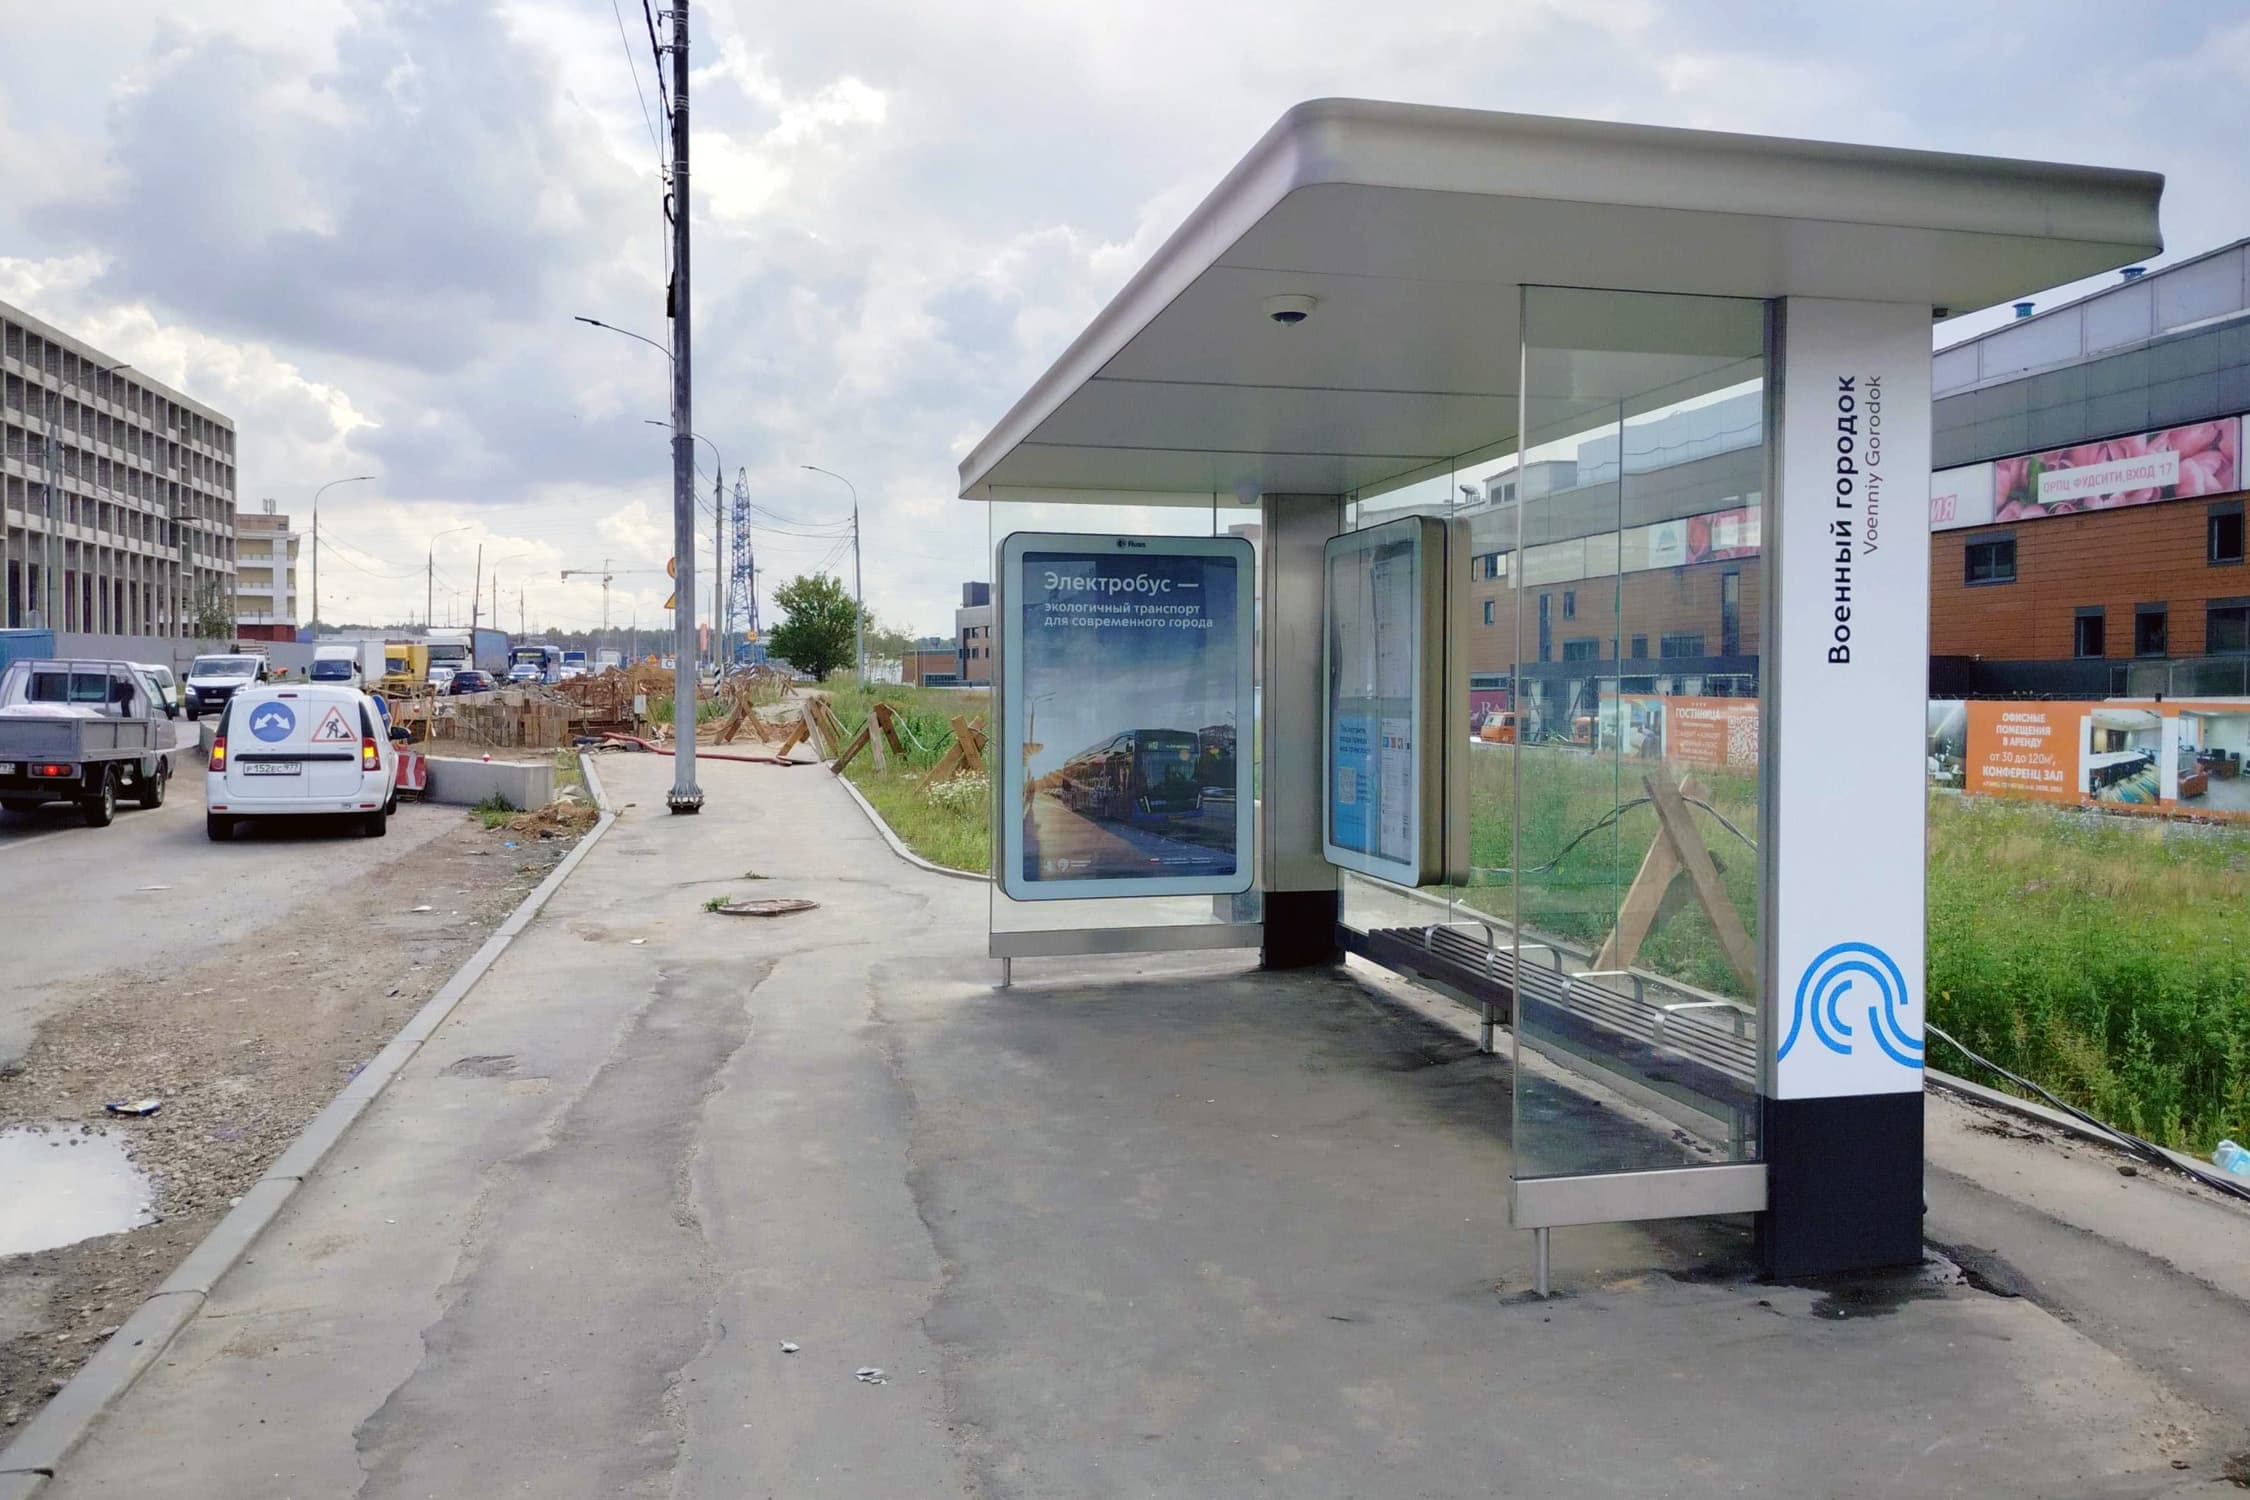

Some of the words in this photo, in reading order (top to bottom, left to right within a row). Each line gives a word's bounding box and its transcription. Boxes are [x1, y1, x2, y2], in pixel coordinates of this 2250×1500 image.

[1864, 375, 1882, 467] Gorodok
[1835, 375, 1858, 509] городок
[2159, 462, 2173, 475] 17
[1863, 472, 1883, 555] Voenniy
[1044, 571, 1171, 596] Электробус
[1828, 517, 1852, 664] Военный
[1045, 602, 1131, 614] экологичный
[1134, 605, 1200, 616] транспорт
[1044, 617, 1069, 627] для
[1072, 617, 1166, 628] современного
[1169, 618, 1214, 629] города
[2002, 751, 2013, 762] 30
[2043, 770, 2064, 782] ЗАЛ
